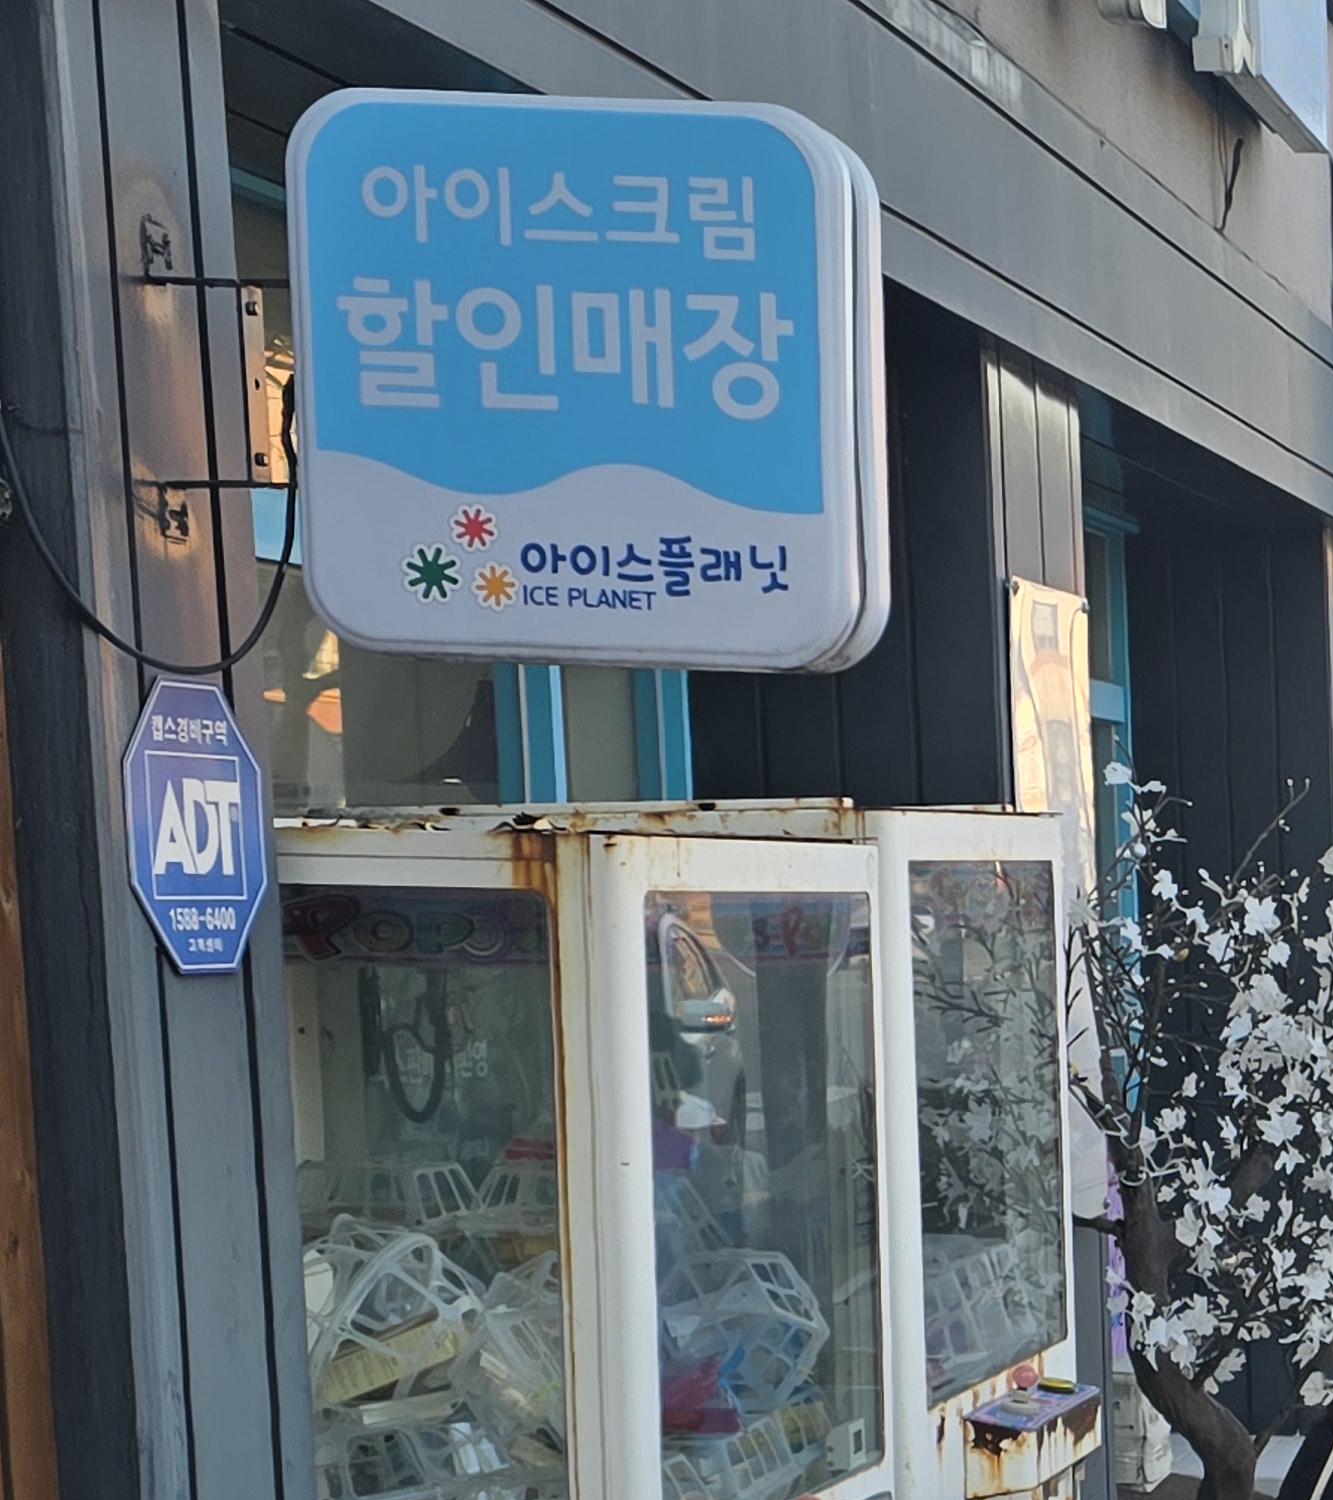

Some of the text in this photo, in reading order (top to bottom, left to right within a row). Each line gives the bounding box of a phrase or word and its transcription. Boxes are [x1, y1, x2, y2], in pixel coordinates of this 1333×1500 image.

[361, 164, 757, 261] 아이스크림
[337, 277, 794, 422] 할인매장
[519, 536, 791, 598] 아이스플래닛
[522, 584, 656, 612] ICE PLANET
[150, 714, 228, 746] 캡스경비구역
[153, 778, 240, 877] ADT
[168, 906, 237, 932] 1588-6400
